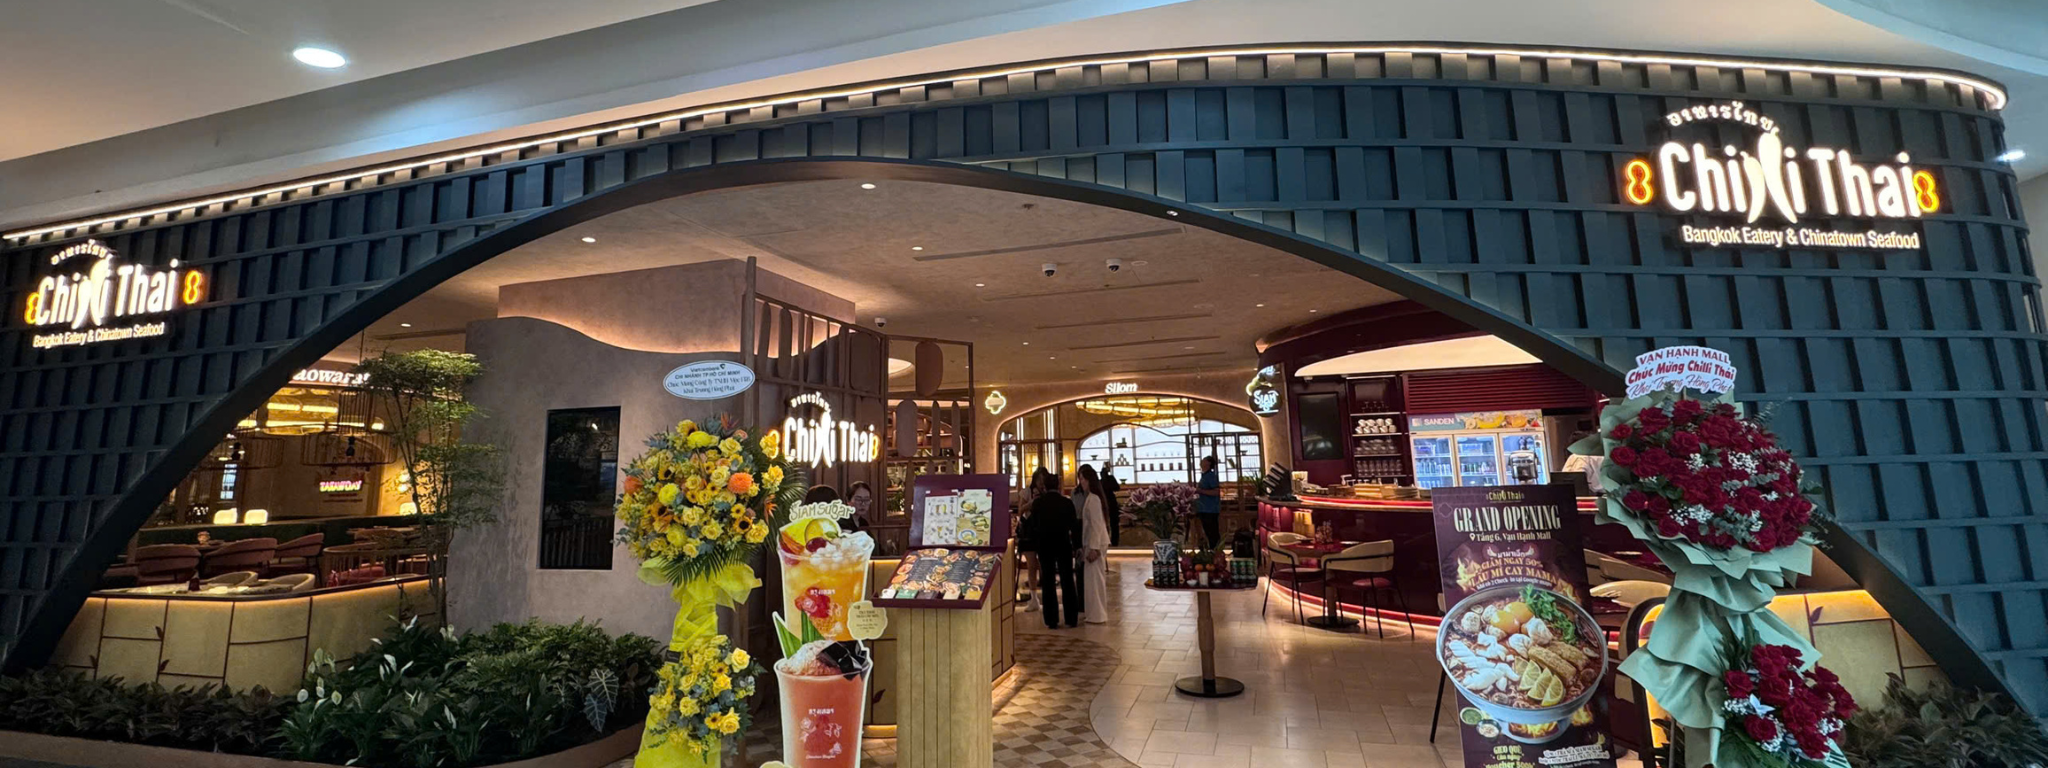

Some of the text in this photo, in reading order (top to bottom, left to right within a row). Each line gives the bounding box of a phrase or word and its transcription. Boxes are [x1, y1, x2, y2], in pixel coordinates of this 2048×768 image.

[1807, 148, 1921, 217] Thai
[1683, 225, 1920, 249] Bangkok Eatery & Chinatown Seafood
[115, 258, 179, 317] Thai
[33, 322, 164, 349] Bangkok Eatery & Chinatown Seafood
[1639, 348, 1729, 366] VẠN HẠNH MALL
[1628, 367, 1653, 384] Chúc
[1655, 361, 1685, 375] Mừng
[1687, 360, 1711, 373] Chilli
[1105, 382, 1138, 394] Silom
[1424, 417, 1454, 426] SANDEN
[839, 422, 875, 462] Thai
[1454, 505, 1561, 532] GRAND OPENING
[1536, 532, 1551, 540] Mall
[1504, 557, 1524, 566] NGAY
[1525, 558, 1543, 568] 50%
[1505, 566, 1524, 575] CAY
[1526, 567, 1557, 584] MAMA
